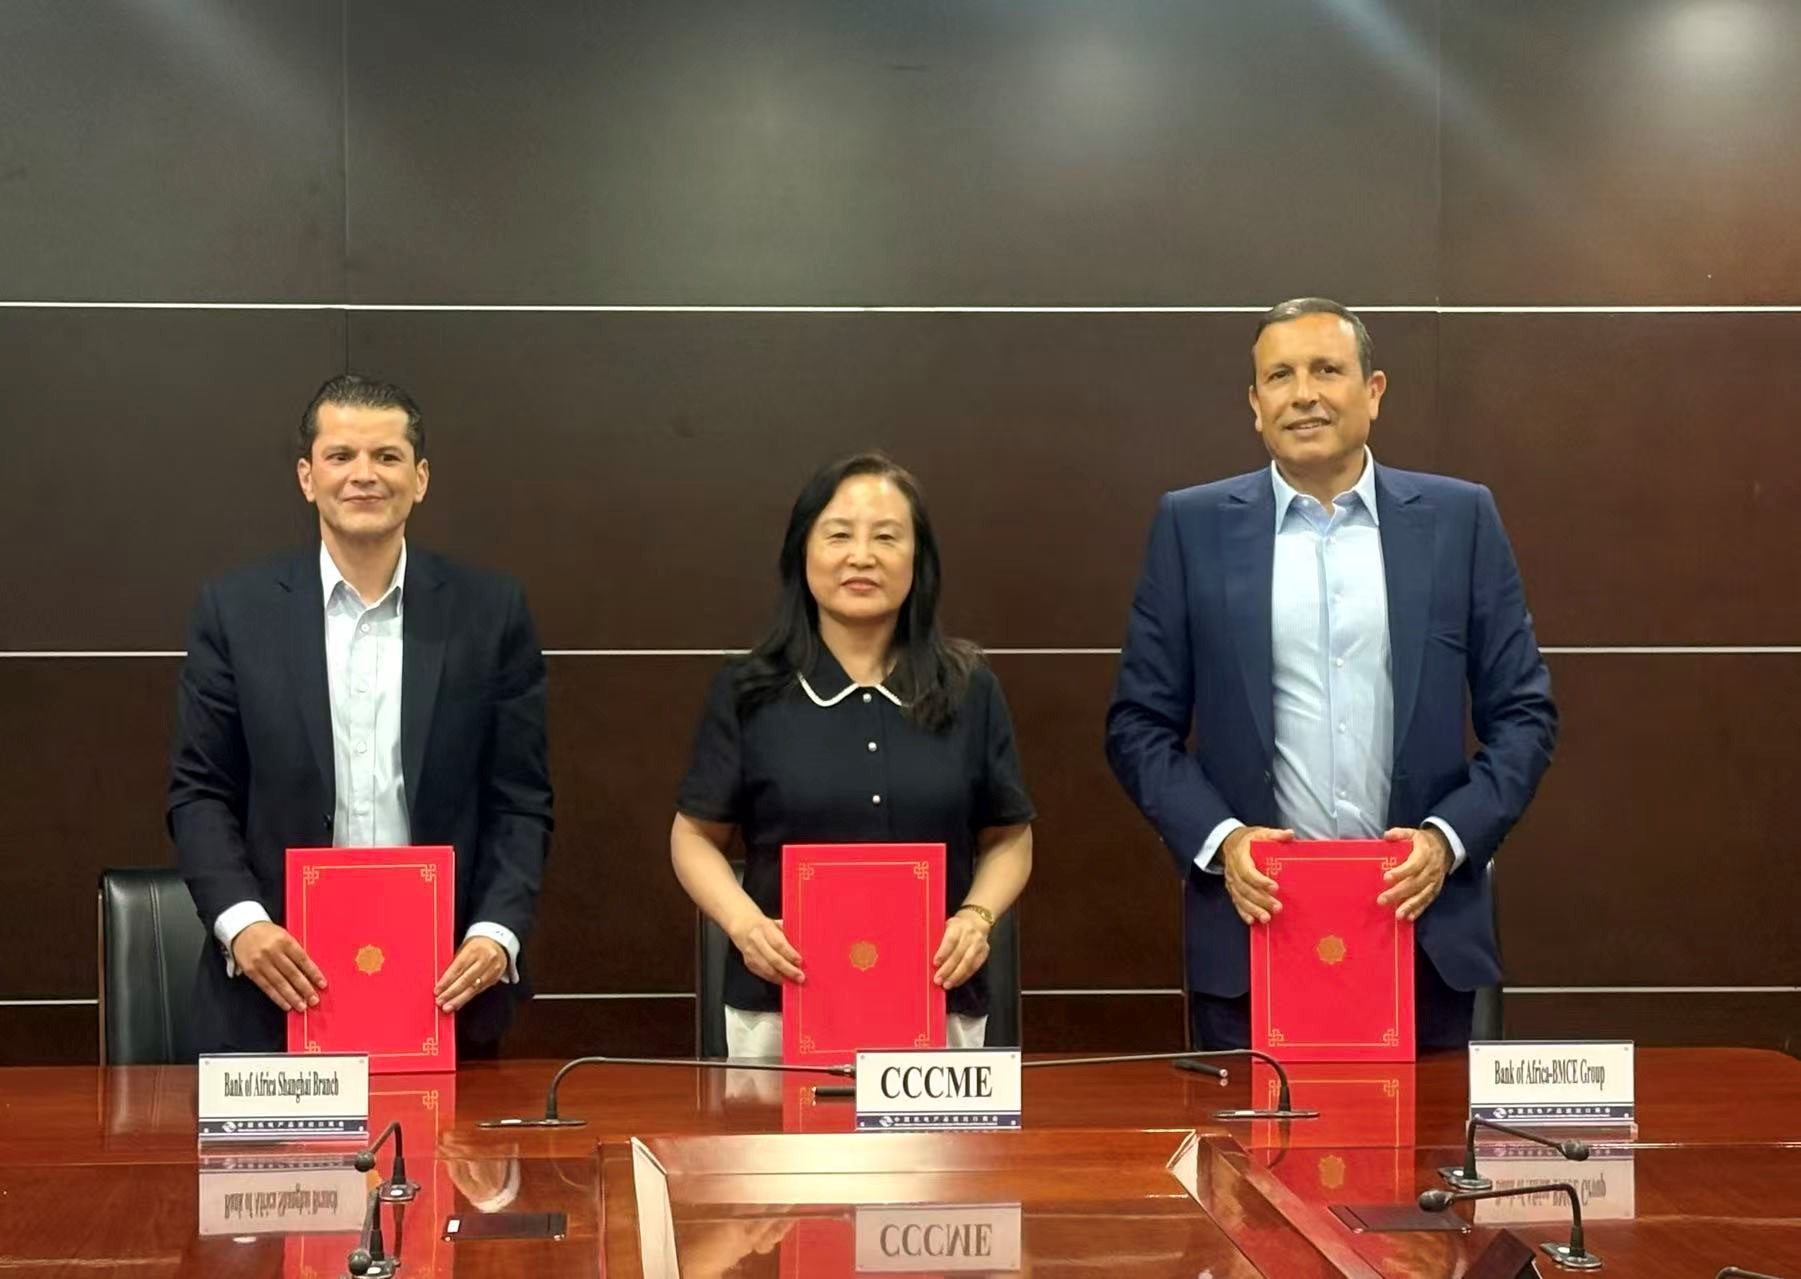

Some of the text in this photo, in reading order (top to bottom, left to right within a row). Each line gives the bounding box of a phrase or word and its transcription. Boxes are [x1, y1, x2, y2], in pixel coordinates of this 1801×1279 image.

[224, 1071, 339, 1103] Bank of Africa Shanghai Branch
[880, 1066, 993, 1099] CCCME
[1494, 1059, 1605, 1091] Bank of Africa-BMCE Group
